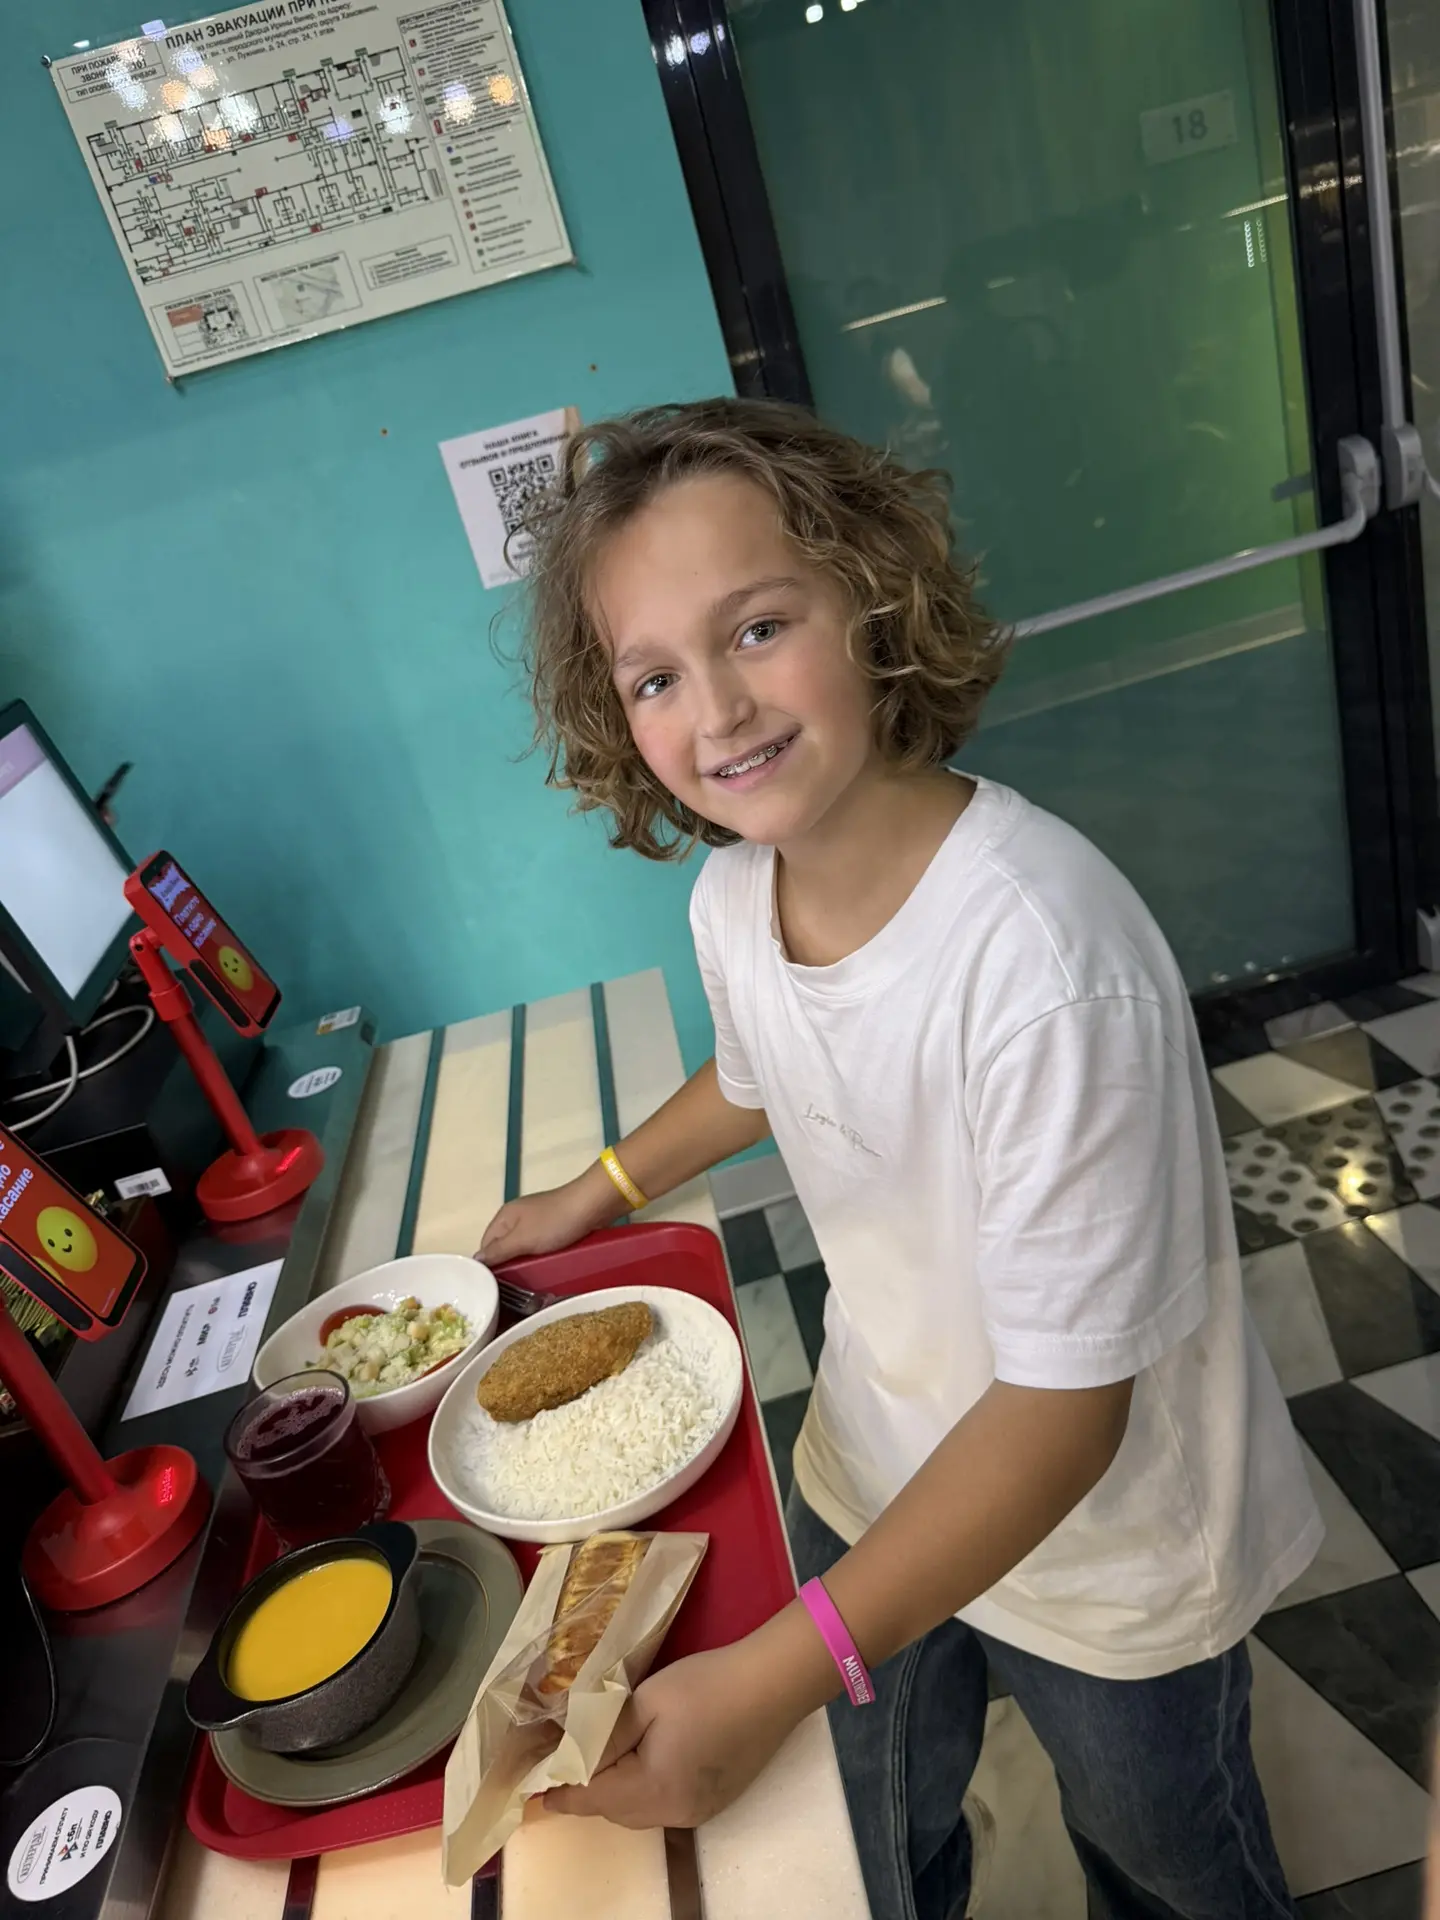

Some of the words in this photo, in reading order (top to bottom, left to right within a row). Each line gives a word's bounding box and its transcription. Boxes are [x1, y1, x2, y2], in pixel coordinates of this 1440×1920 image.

[166, 29, 204, 49] ПЛАН
[206, 4, 286, 38] ЭВАКУАЦИИ
[288, 0, 317, 15] ПРИ
[71, 64, 88, 76] ПРИ
[88, 54, 122, 71] ПОЖАРЕ
[1172, 108, 1209, 144] 18
[39, 1835, 60, 1885] ПРИНИМАЕМ
[55, 1807, 68, 1836] ОПЛАТУ
[67, 1823, 78, 1843] сбп
[95, 1810, 113, 1850] ПЛАВНО
